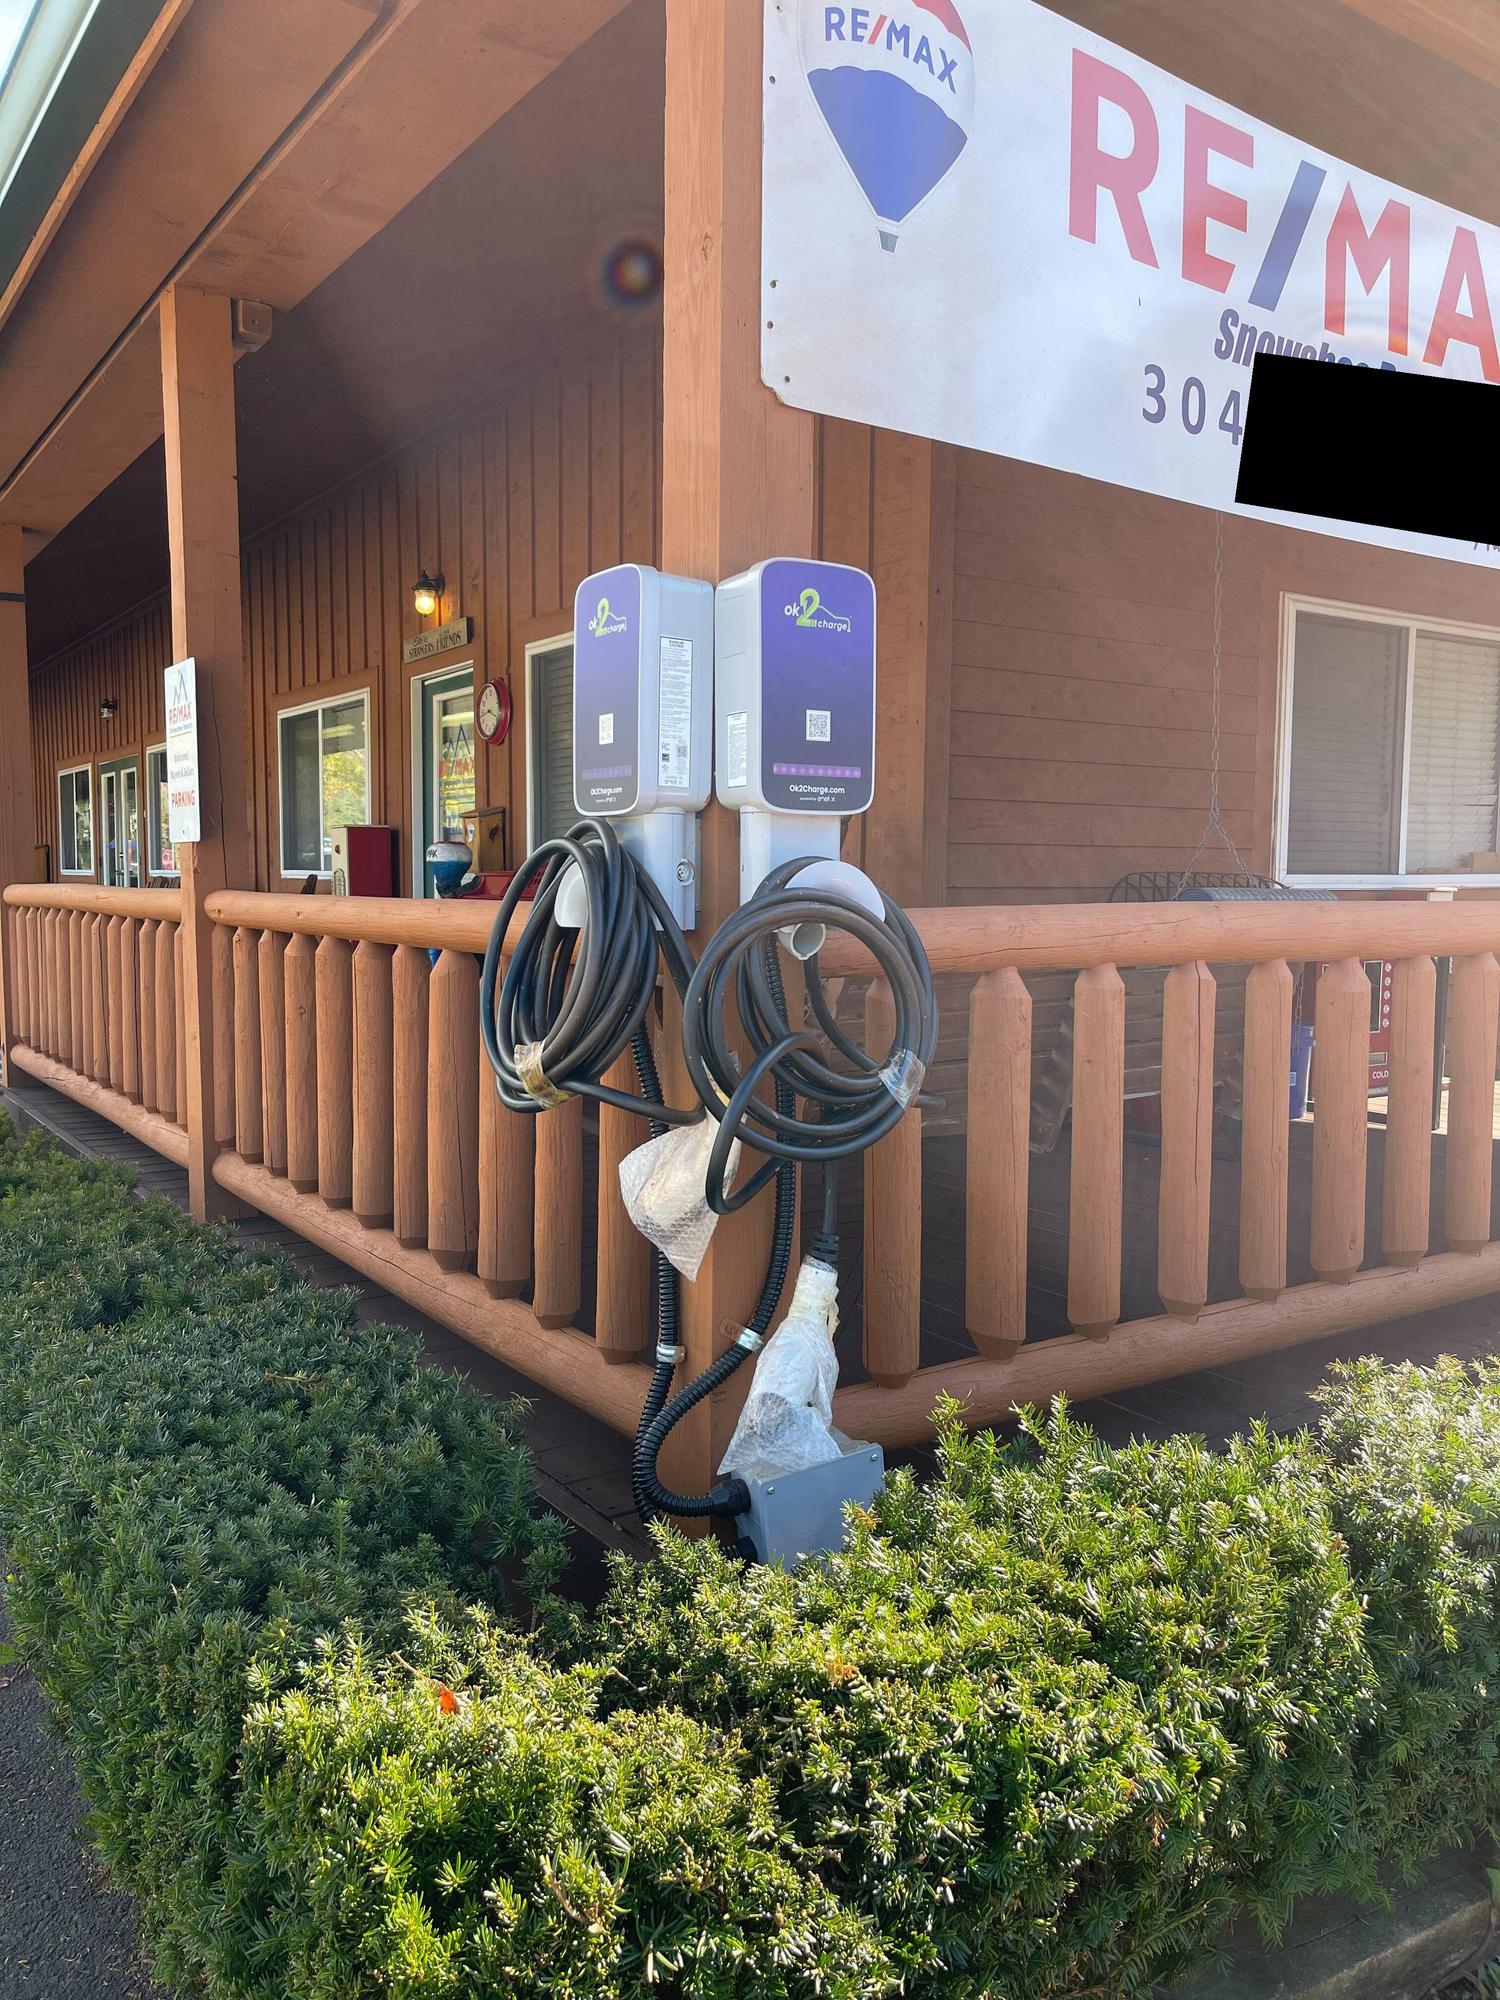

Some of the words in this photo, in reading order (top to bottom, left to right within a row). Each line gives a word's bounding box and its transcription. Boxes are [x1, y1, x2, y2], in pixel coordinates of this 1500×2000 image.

[824, 6, 958, 95] RE/MAX
[789, 784, 845, 795] Ok2Charge.com
[171, 790, 195, 808] PARKING
[1373, 1070, 1389, 1079] COLD
